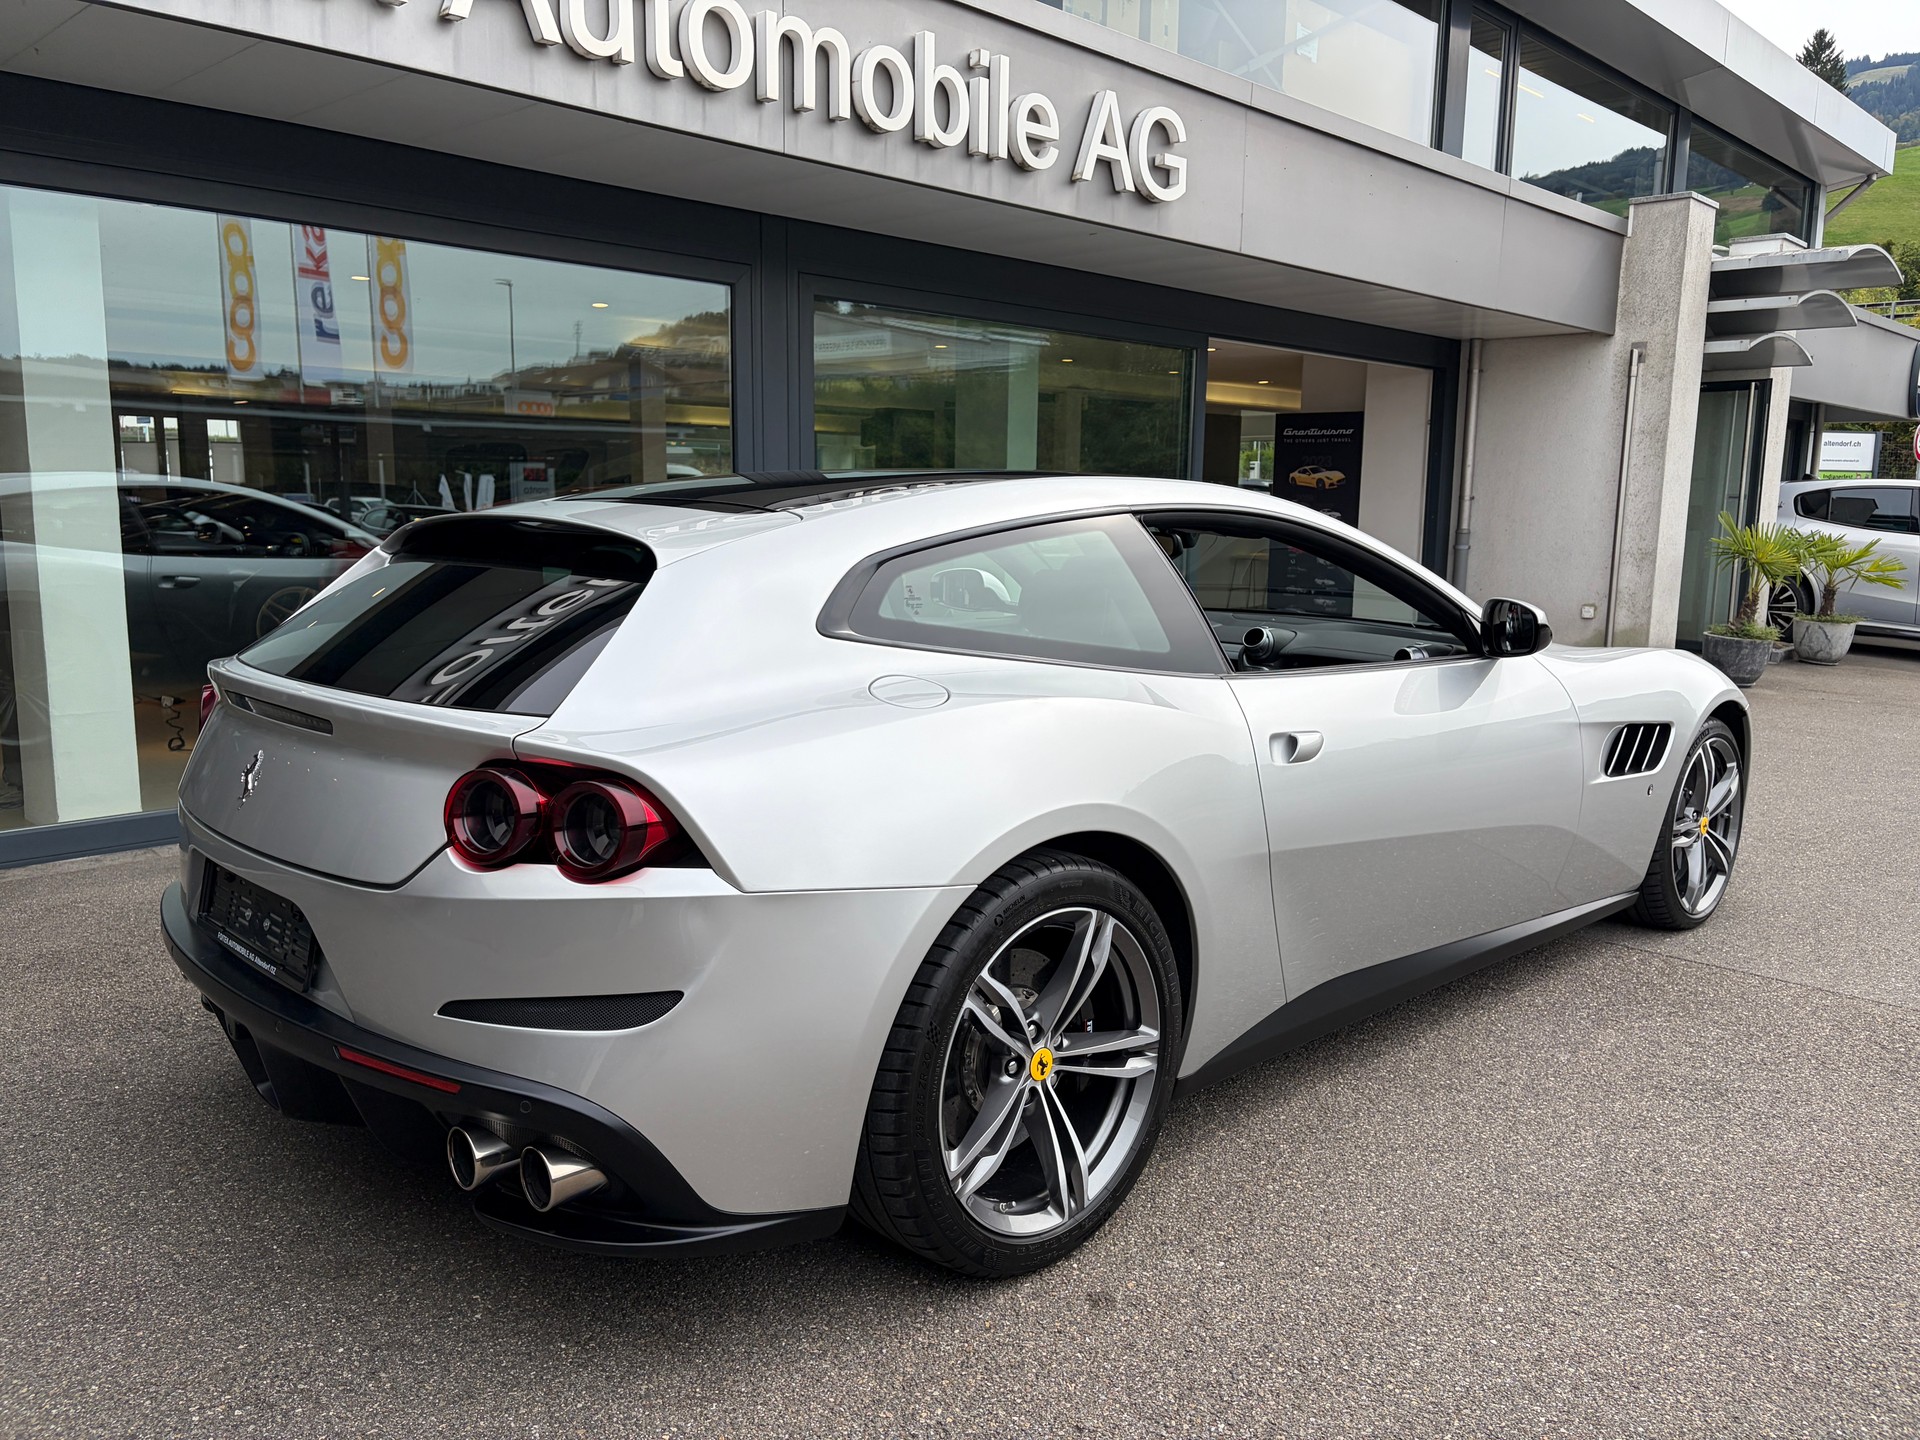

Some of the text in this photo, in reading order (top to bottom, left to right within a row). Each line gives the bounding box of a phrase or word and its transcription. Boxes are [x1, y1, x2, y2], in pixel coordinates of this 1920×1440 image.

[1071, 89, 1188, 203] AG
[223, 221, 257, 372] coop
[298, 224, 341, 345] reka
[1003, 895, 1026, 914] MICHELIN
